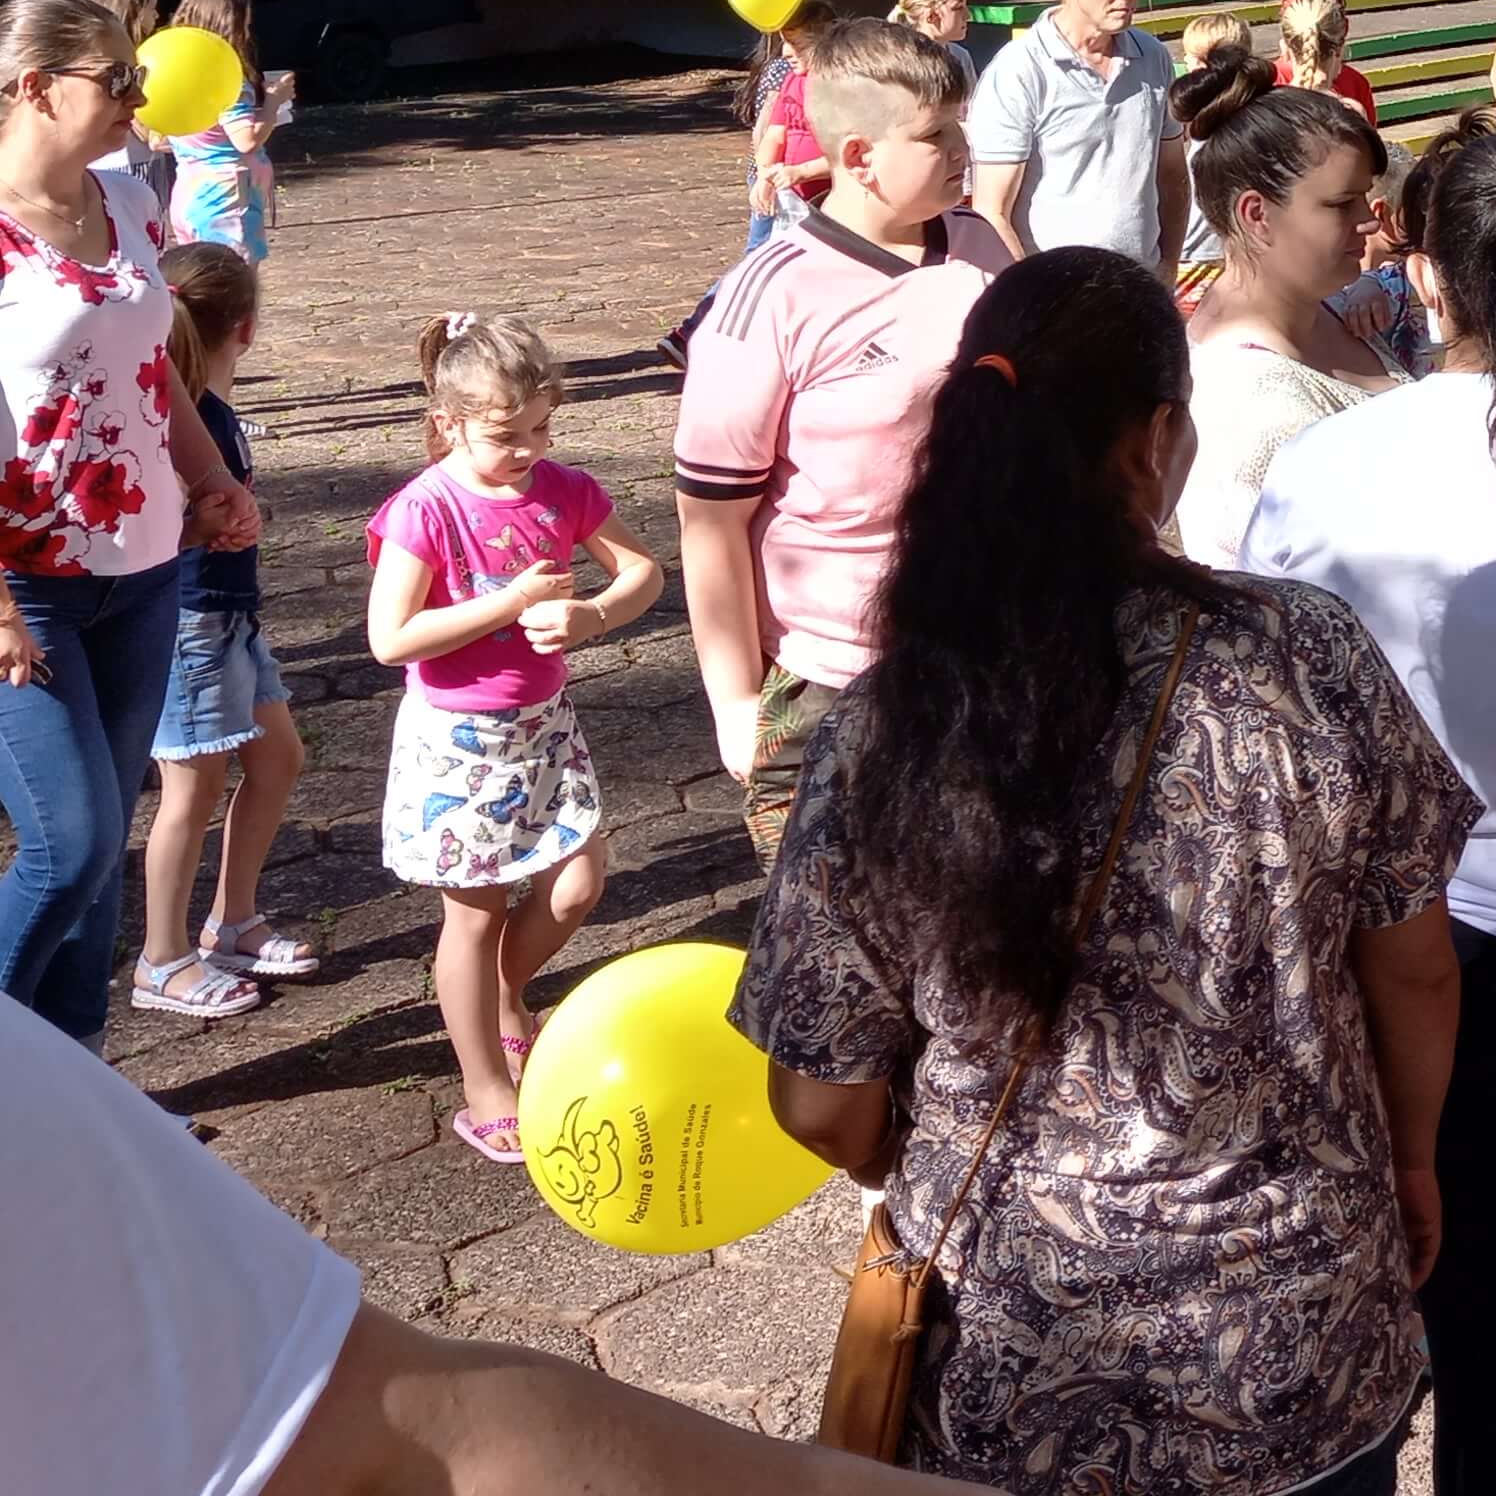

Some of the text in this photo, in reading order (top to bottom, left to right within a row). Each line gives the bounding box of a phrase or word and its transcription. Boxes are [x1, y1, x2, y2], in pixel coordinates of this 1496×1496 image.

[856, 355, 899, 371] adidas
[681, 1136, 690, 1148] de
[625, 1105, 654, 1225] Vacina é Saúde!
[677, 1150, 689, 1192] Municipal
